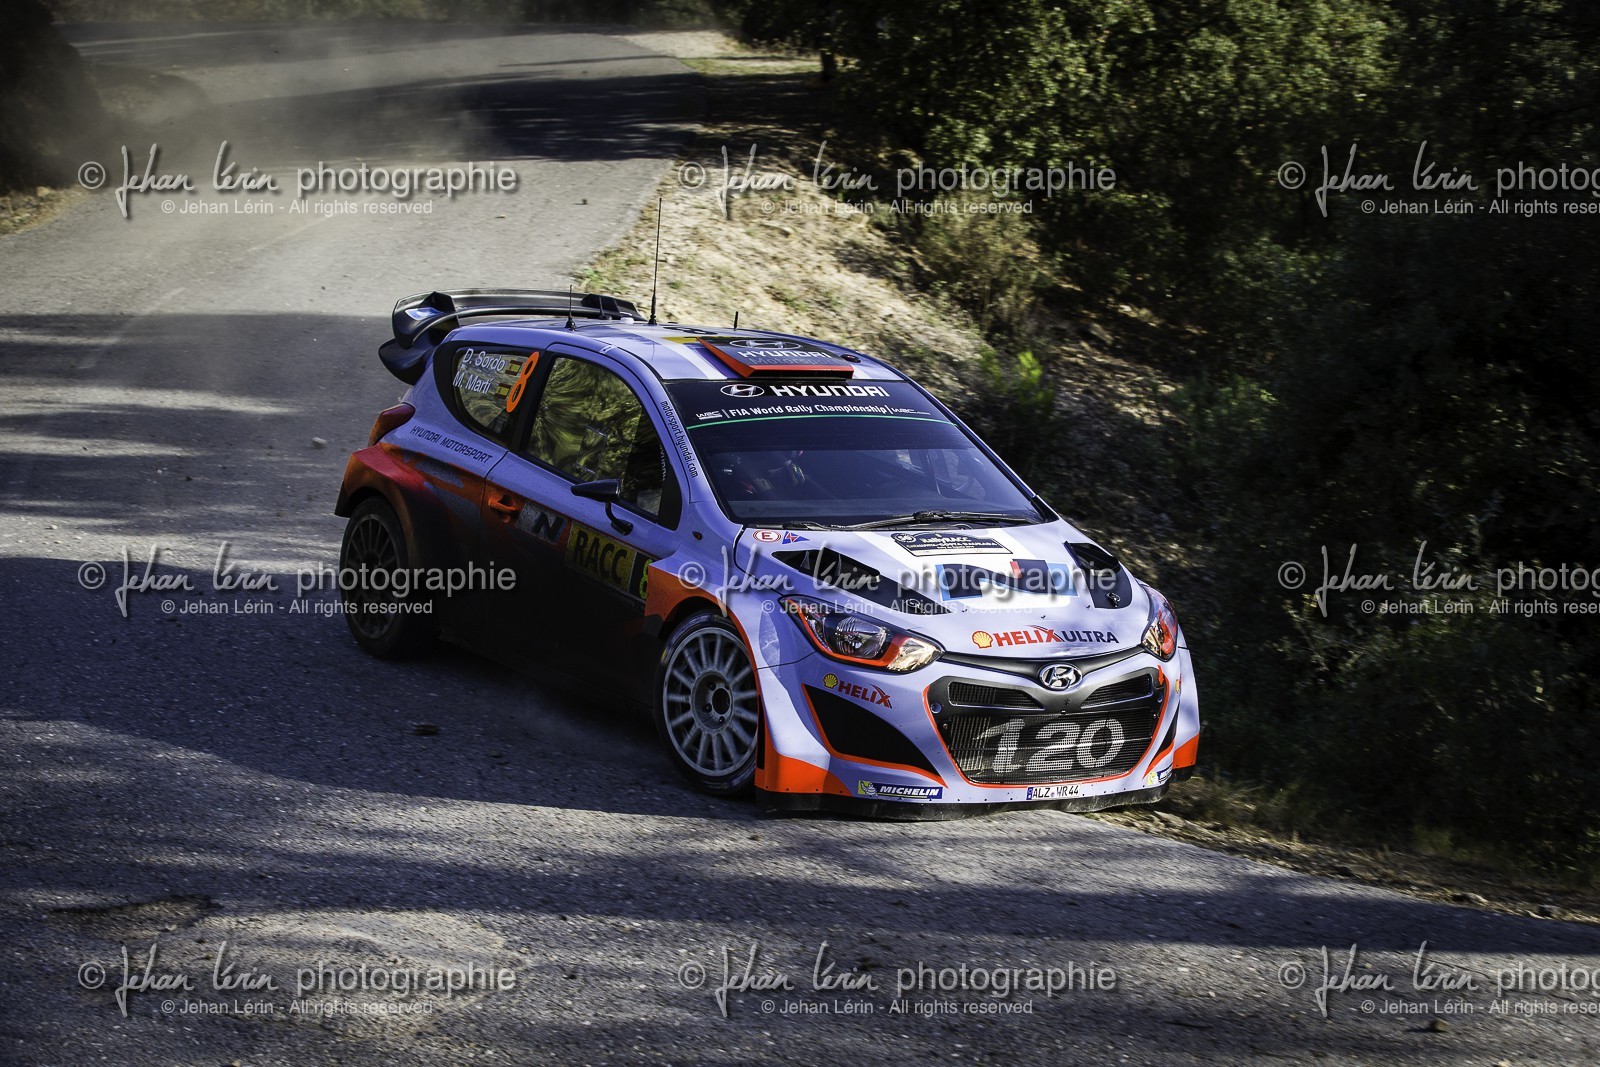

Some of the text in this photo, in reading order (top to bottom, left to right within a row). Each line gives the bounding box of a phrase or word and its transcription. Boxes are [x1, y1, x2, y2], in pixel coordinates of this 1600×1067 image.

[462, 348, 506, 372] D. Sordo
[738, 350, 832, 359] HYUNDAI
[452, 371, 494, 394] M. Martí
[506, 351, 540, 413] 8
[770, 385, 890, 397] HYUNDAI
[729, 409, 751, 417] FIA
[750, 406, 784, 415] World
[785, 404, 813, 414] Rally
[814, 404, 887, 414] Championship
[410, 425, 492, 464] HYUNDAI MOTORSPORT
[660, 400, 699, 479] motorsport.hyundai.com
[761, 532, 773, 540] E
[572, 530, 627, 584] RACC
[992, 627, 1120, 646] HELIX ULTRA
[838, 681, 892, 709] HELIX
[880, 785, 940, 796] MICHELIN
[1033, 787, 1051, 798] ALZ
